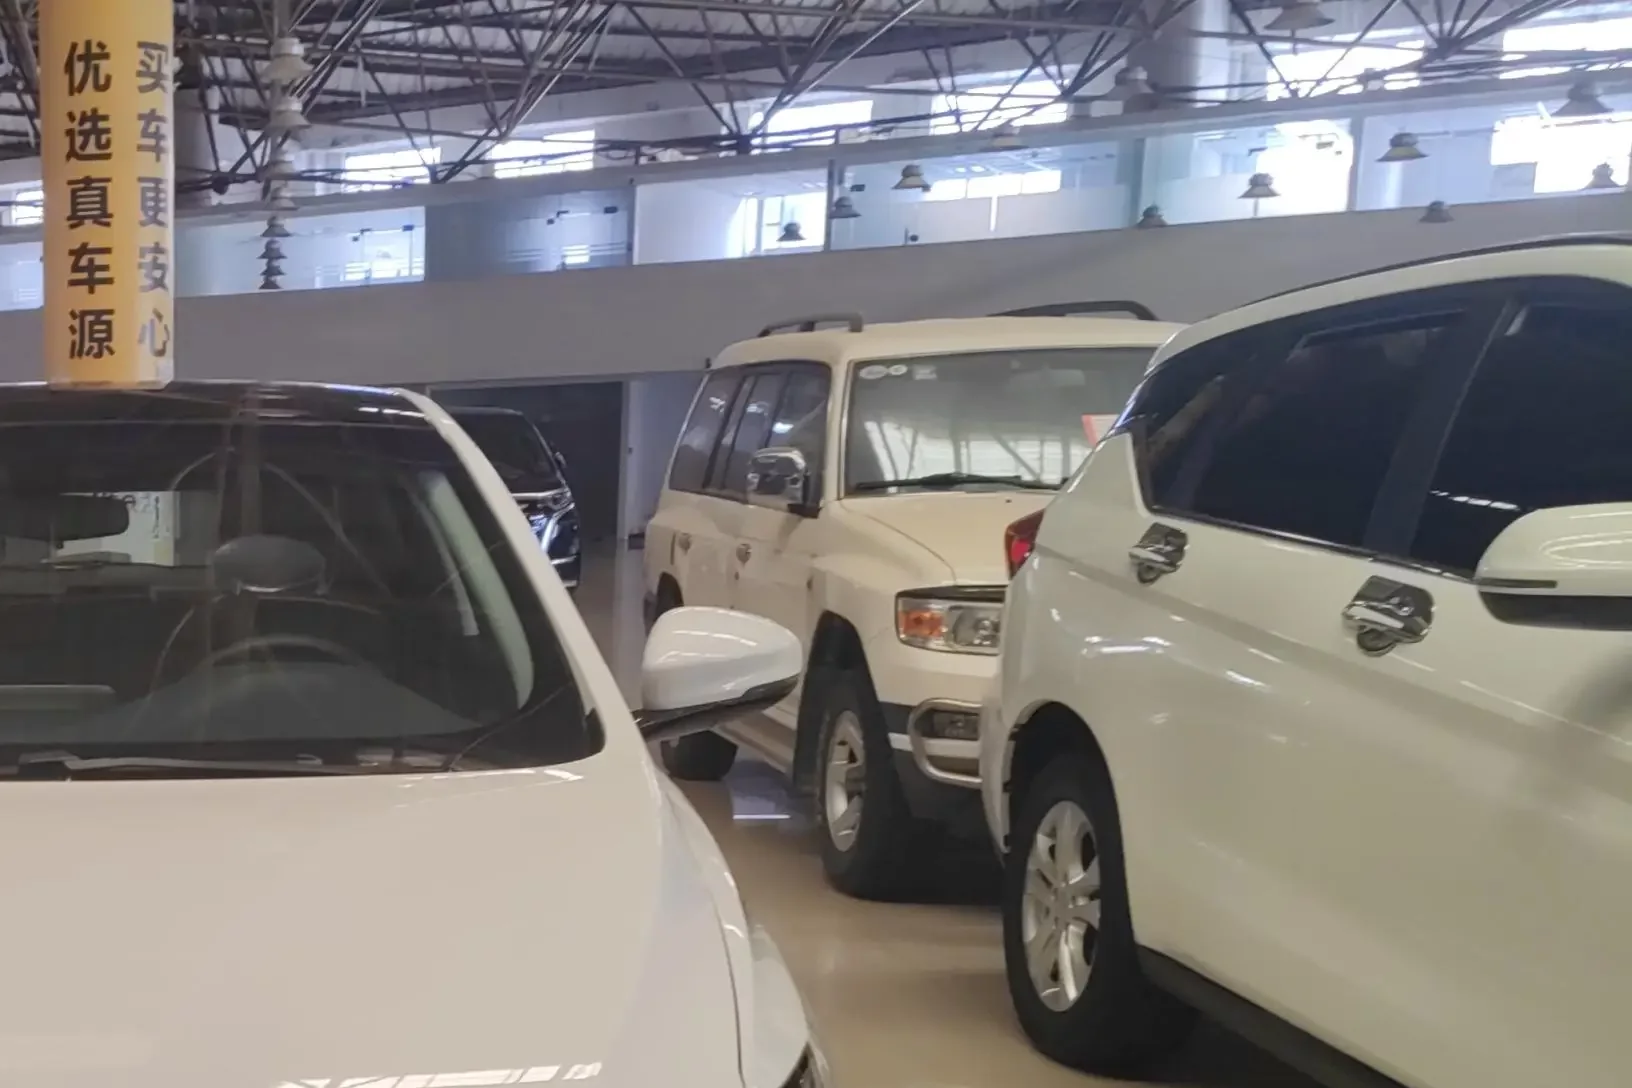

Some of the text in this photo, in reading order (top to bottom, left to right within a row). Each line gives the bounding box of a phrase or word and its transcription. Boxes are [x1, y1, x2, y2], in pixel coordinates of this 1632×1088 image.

[63, 38, 116, 360] 优选真车源
[136, 40, 171, 358] 买车更安心
